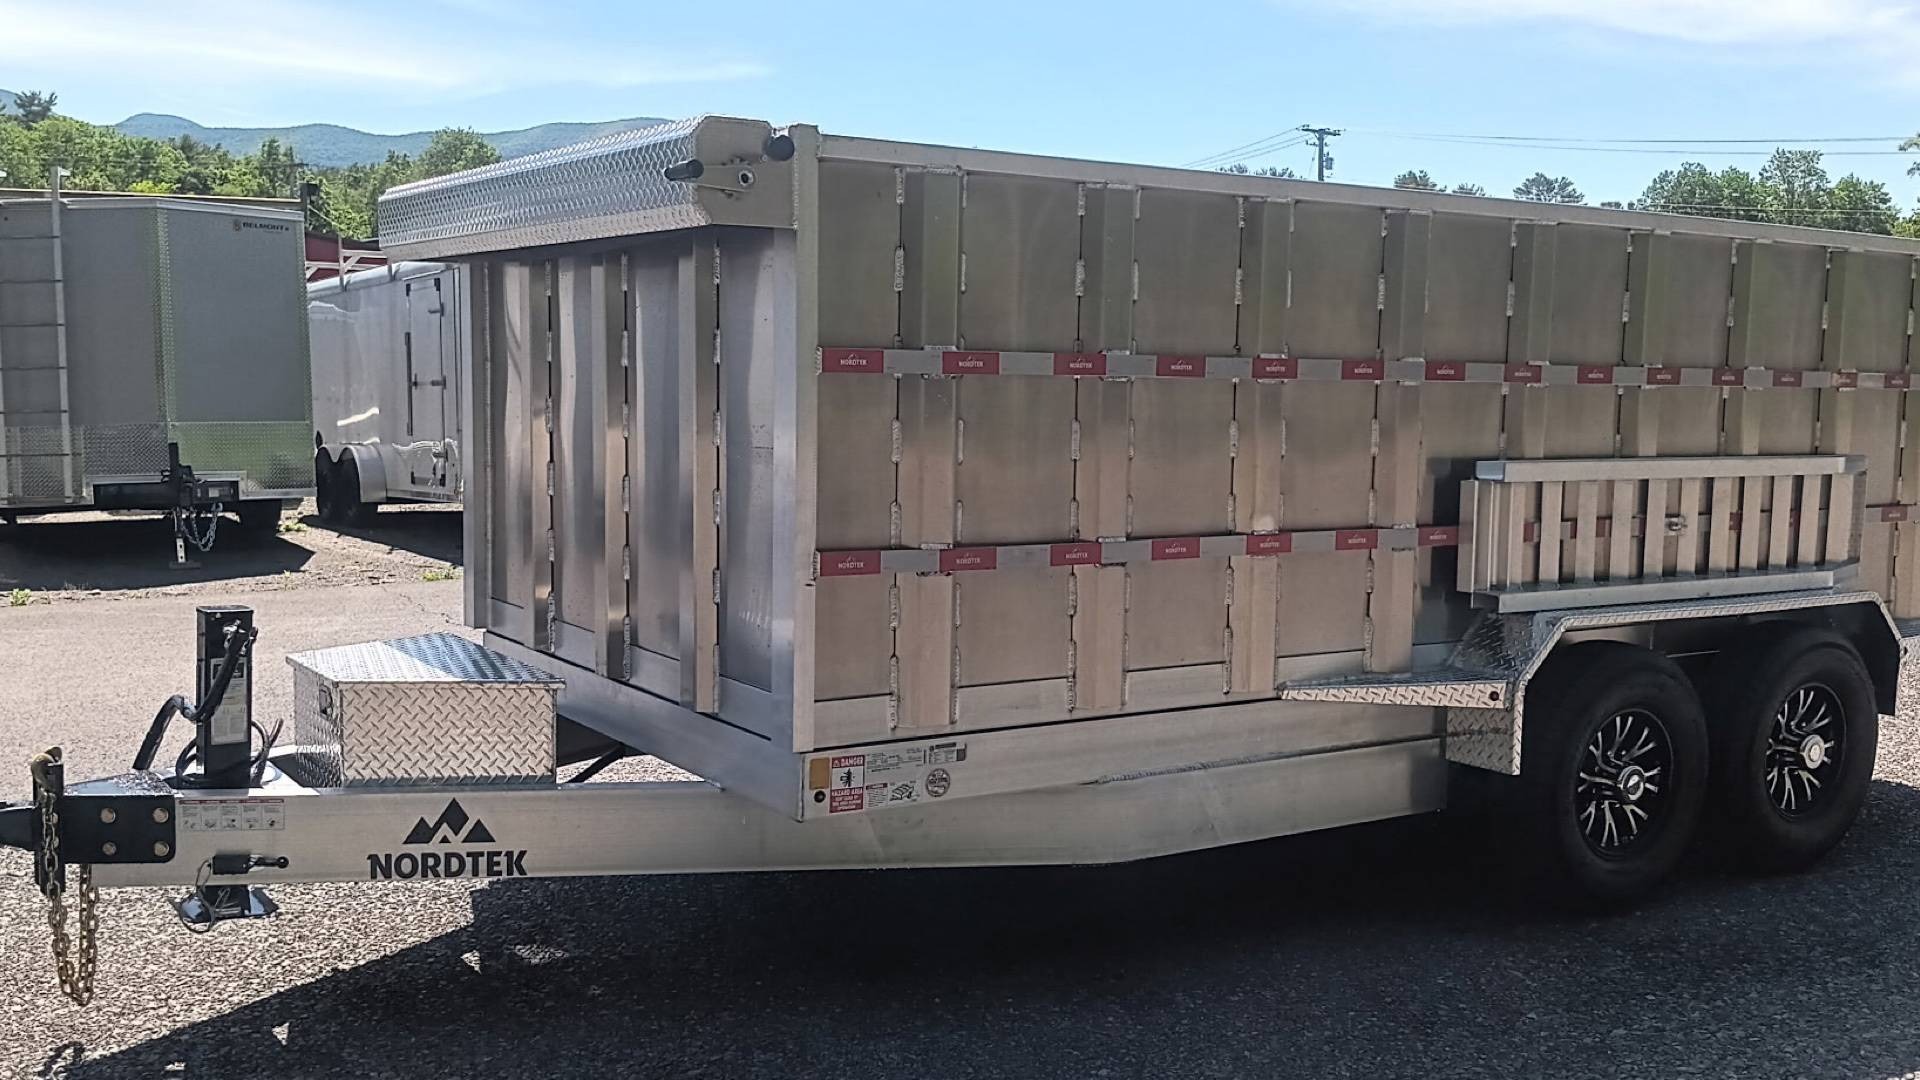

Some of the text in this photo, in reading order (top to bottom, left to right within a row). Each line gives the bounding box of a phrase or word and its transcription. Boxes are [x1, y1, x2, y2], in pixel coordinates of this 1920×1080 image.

[840, 358, 867, 366] NORDTEK
[958, 360, 984, 368] NORDTEK
[838, 561, 864, 569] NORDTEK
[956, 557, 981, 565] NORDTEK
[840, 756, 864, 767] DANGER
[366, 850, 528, 880] NORDTEK
